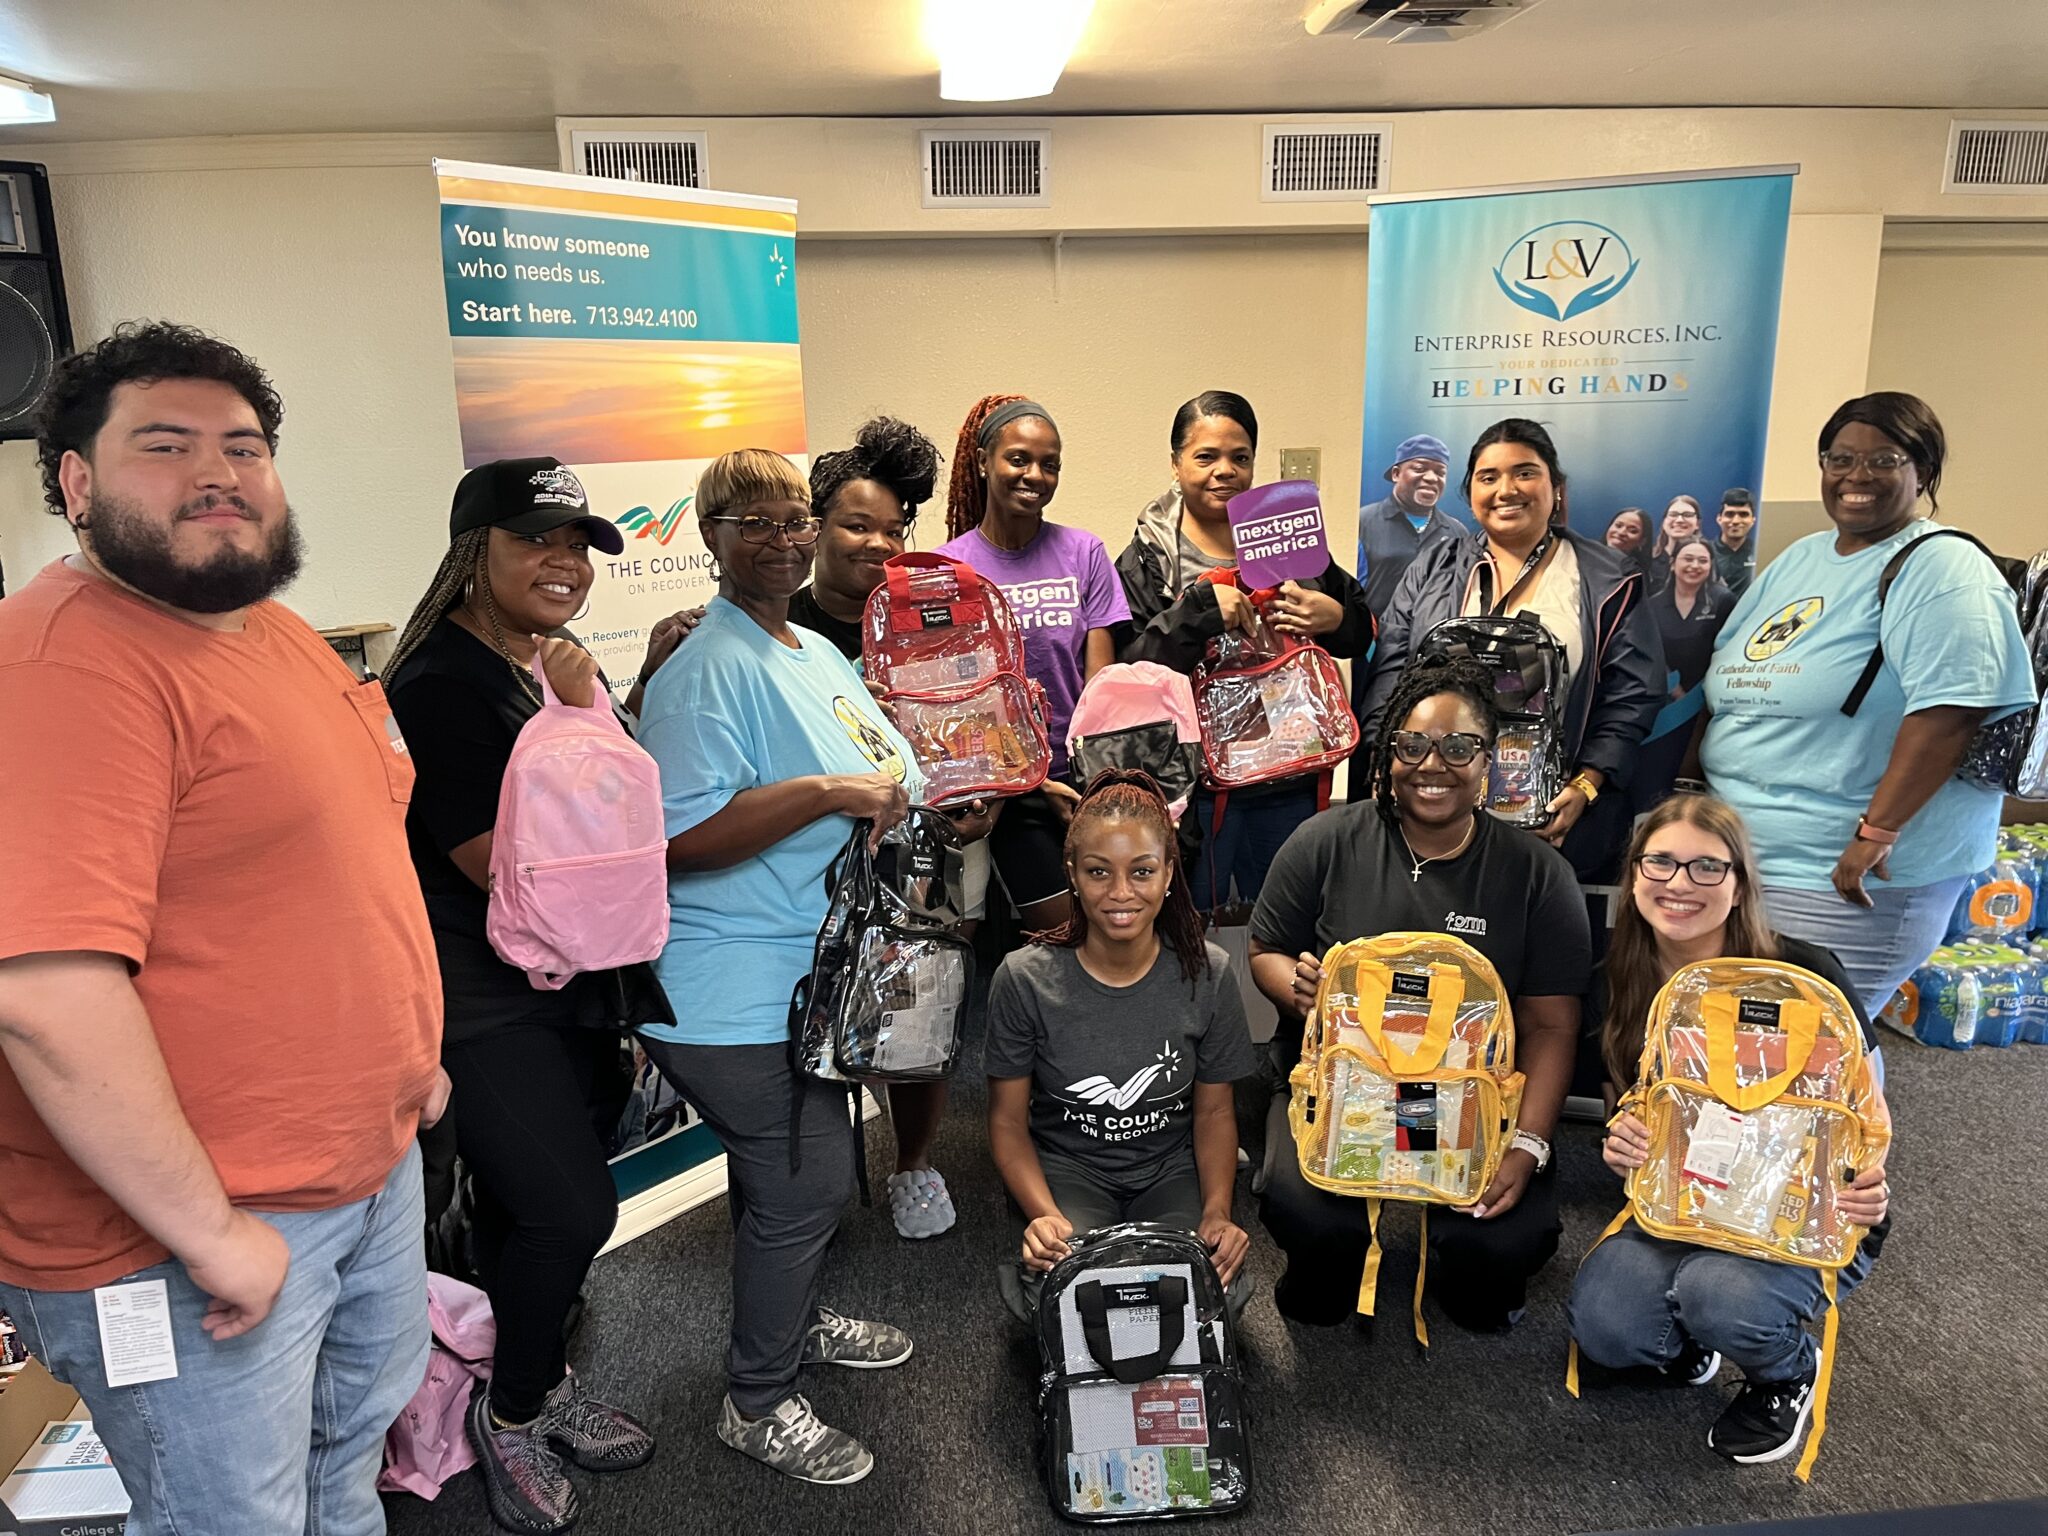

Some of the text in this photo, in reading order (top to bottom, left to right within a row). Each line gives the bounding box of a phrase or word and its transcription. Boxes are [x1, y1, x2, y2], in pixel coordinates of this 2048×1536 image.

[455, 224, 650, 259] You know someone
[1525, 237, 1611, 280] L&V
[458, 262, 605, 285] who needs us.
[463, 300, 698, 329] Start here. 713.942.4100
[1499, 357, 1619, 370] YOUR DEDICATED
[1432, 373, 1690, 398] HELPING HANDS
[1240, 514, 1315, 541] nextgen
[1244, 535, 1318, 561] america
[607, 553, 711, 579] THE COUNC
[629, 576, 711, 595] ON RECOVERY
[593, 629, 639, 642] Recovery
[604, 643, 645, 656] providing
[1716, 663, 1801, 675] Cathedral of Faith
[1727, 677, 1772, 691] Fellowship
[1501, 751, 1528, 761] USA
[1445, 911, 1487, 931] form
[1063, 1106, 1098, 1125] THE
[1081, 1113, 1170, 1141] ON RECOVERY
[65, 1440, 94, 1465] FILLER
[61, 1524, 115, 1536] College
